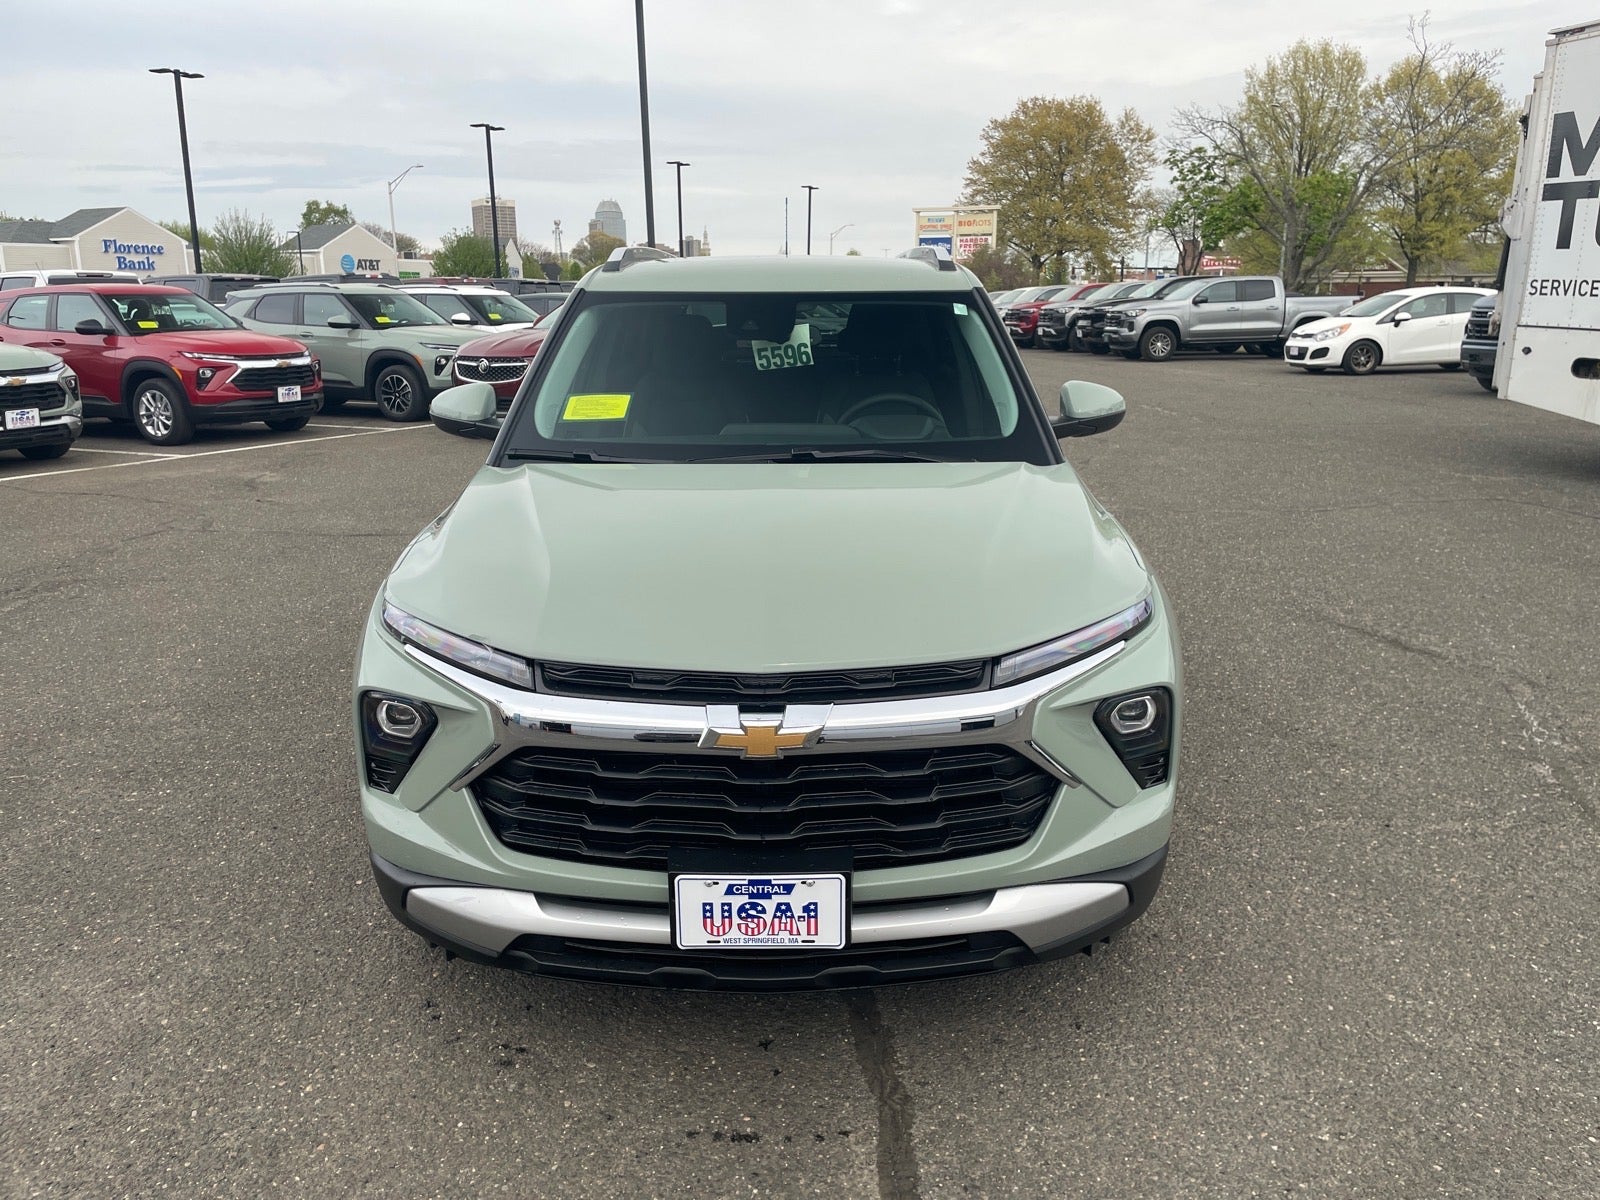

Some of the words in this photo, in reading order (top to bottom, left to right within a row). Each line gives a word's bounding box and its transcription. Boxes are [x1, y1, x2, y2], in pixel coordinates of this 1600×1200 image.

[1542, 180, 1600, 250] T
[102, 238, 164, 255] Florence
[116, 255, 155, 271] Bank
[356, 258, 381, 271] AT&T
[1528, 278, 1600, 297] SERVICE
[757, 342, 812, 370] 5596
[732, 884, 788, 895] CENTRAL
[702, 901, 819, 937] USA-1
[723, 937, 742, 945] WEST
[743, 937, 787, 945] SPRINGFIELD,
[788, 937, 799, 945] MA
